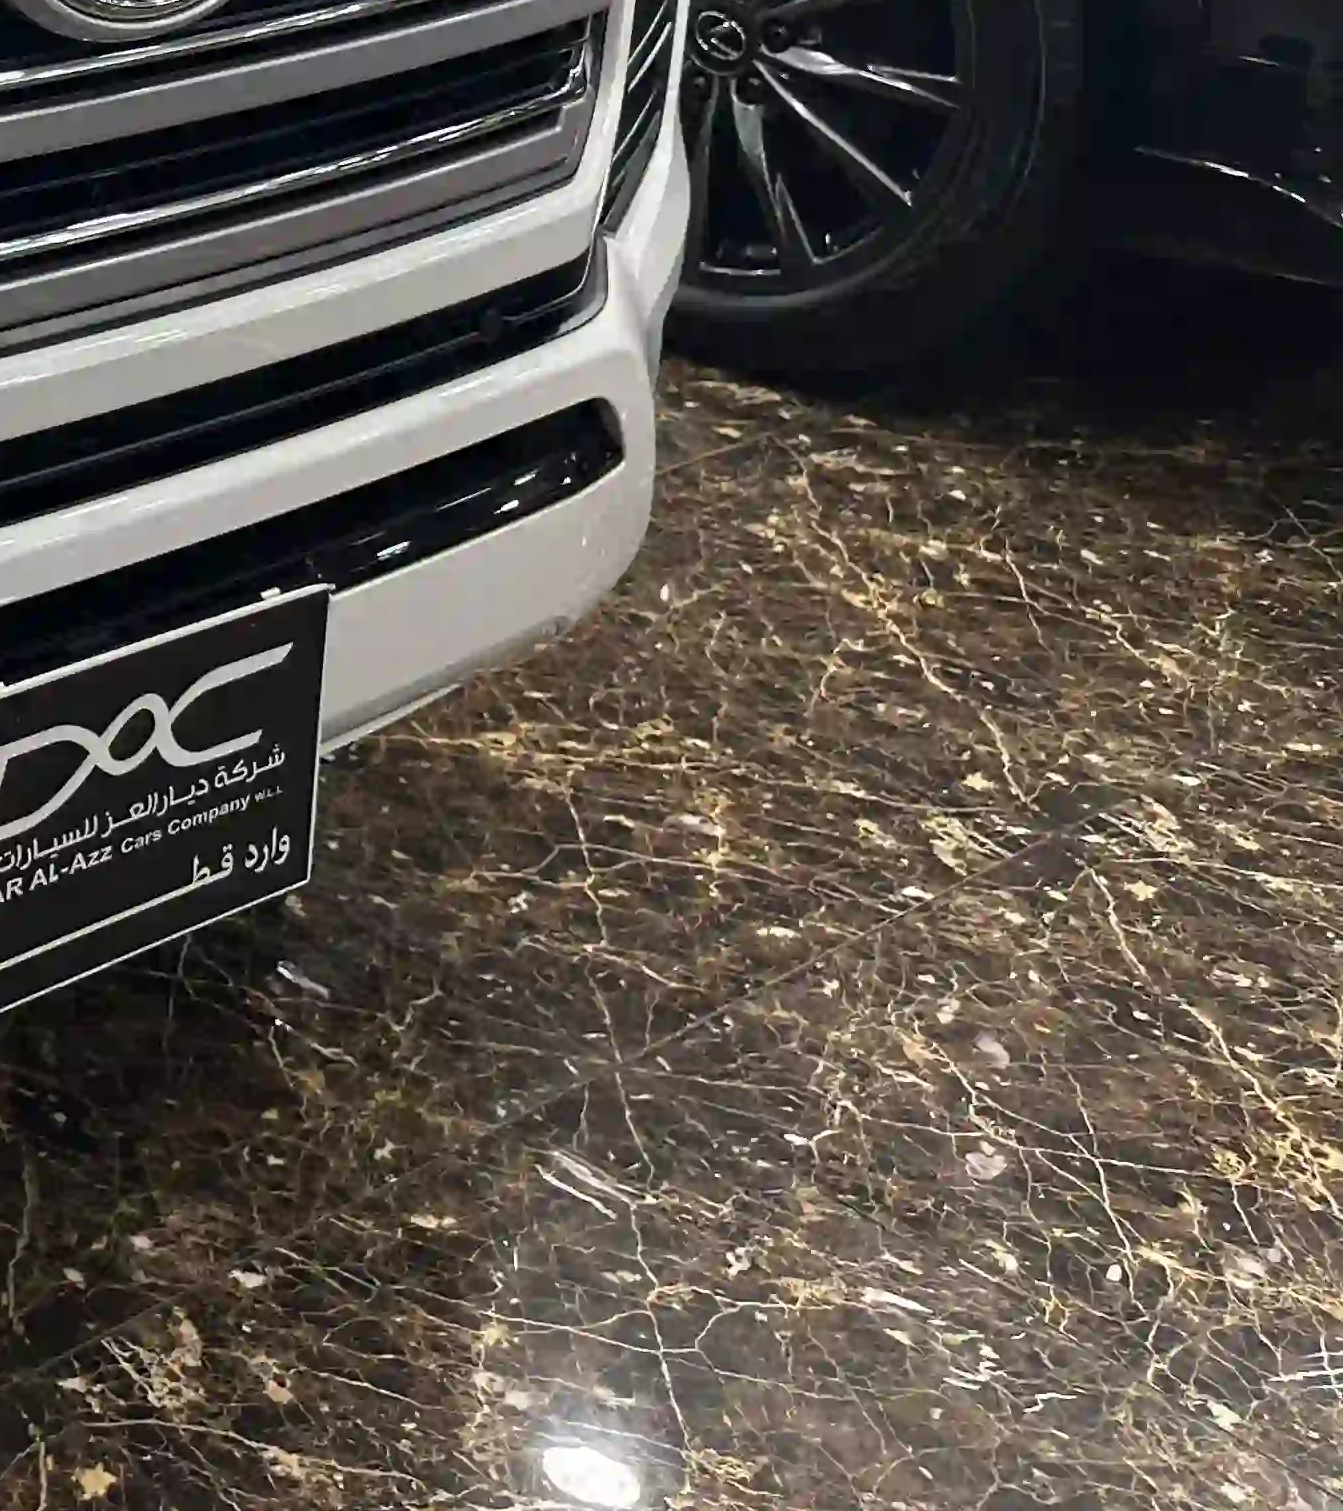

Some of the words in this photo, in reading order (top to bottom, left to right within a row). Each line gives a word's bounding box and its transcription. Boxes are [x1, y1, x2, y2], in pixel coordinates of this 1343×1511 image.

[215, 743, 286, 788] شركة
[100, 791, 159, 838] العز
[156, 778, 210, 817] ديار
[120, 828, 163, 854] Cars
[167, 793, 241, 835] Company
[244, 825, 291, 873] وارد
